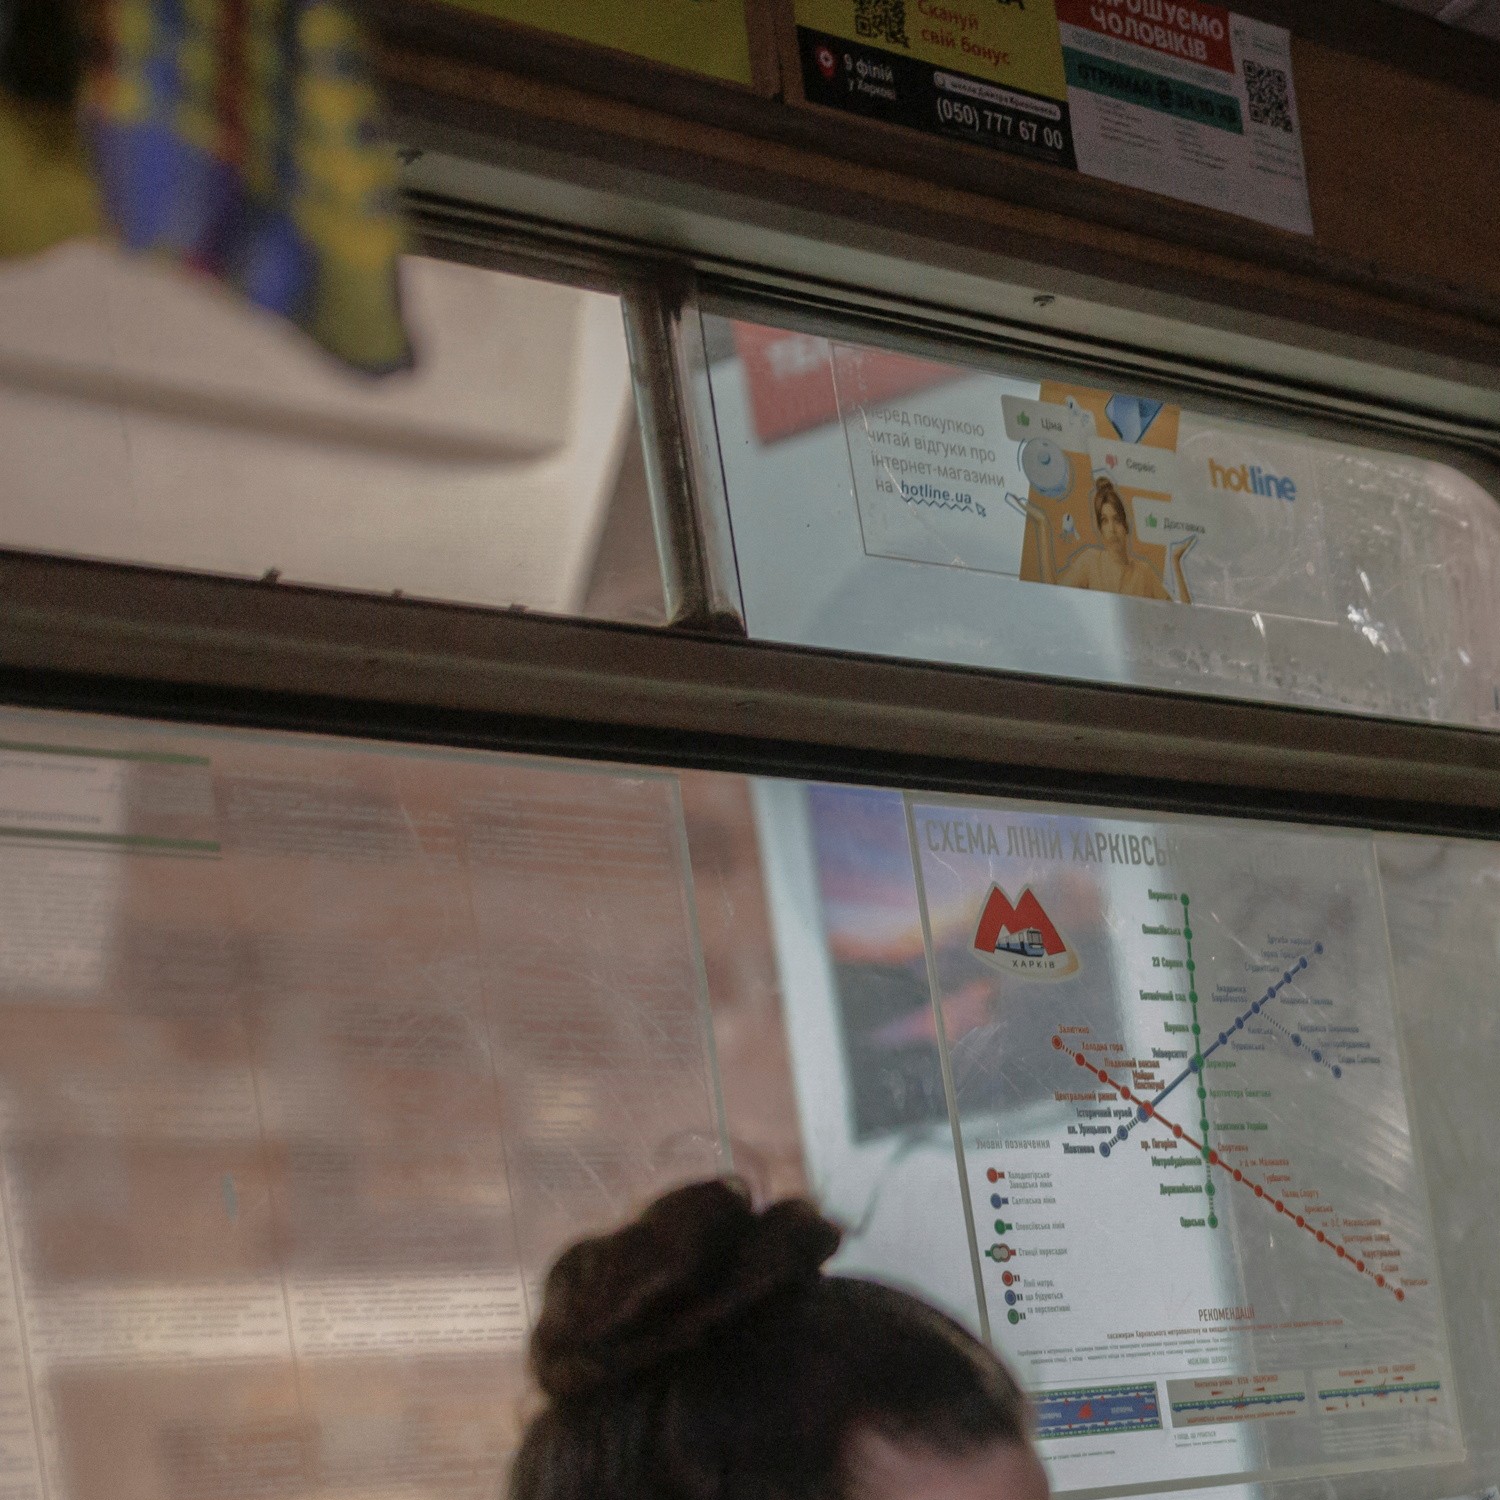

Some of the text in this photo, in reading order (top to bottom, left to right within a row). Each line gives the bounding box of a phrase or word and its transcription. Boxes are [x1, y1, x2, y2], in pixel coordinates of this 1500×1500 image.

[917, 0, 978, 31] Скануй
[921, 28, 1010, 66] свій бонус
[1090, 7, 1207, 61] ЧОЛОВІКІВ
[843, 54, 893, 82] 9 філій
[936, 96, 979, 132] (050)
[983, 110, 1012, 135] 777
[1018, 120, 1038, 143] 67
[1043, 127, 1063, 150] 00
[914, 411, 985, 440] покупкою
[914, 434, 966, 462] відгуки
[970, 445, 997, 465] про
[871, 452, 1006, 490] інтернет-магазини
[1208, 457, 1298, 502] hotline
[875, 477, 973, 505] на hotline.ua
[925, 819, 999, 856] СХЕМА
[1007, 821, 1064, 860] ЛІНІЙ
[1012, 958, 1055, 970] ХАРКІВ
[1198, 1303, 1255, 1321] РЕКОМЕНДАЦІЇ
